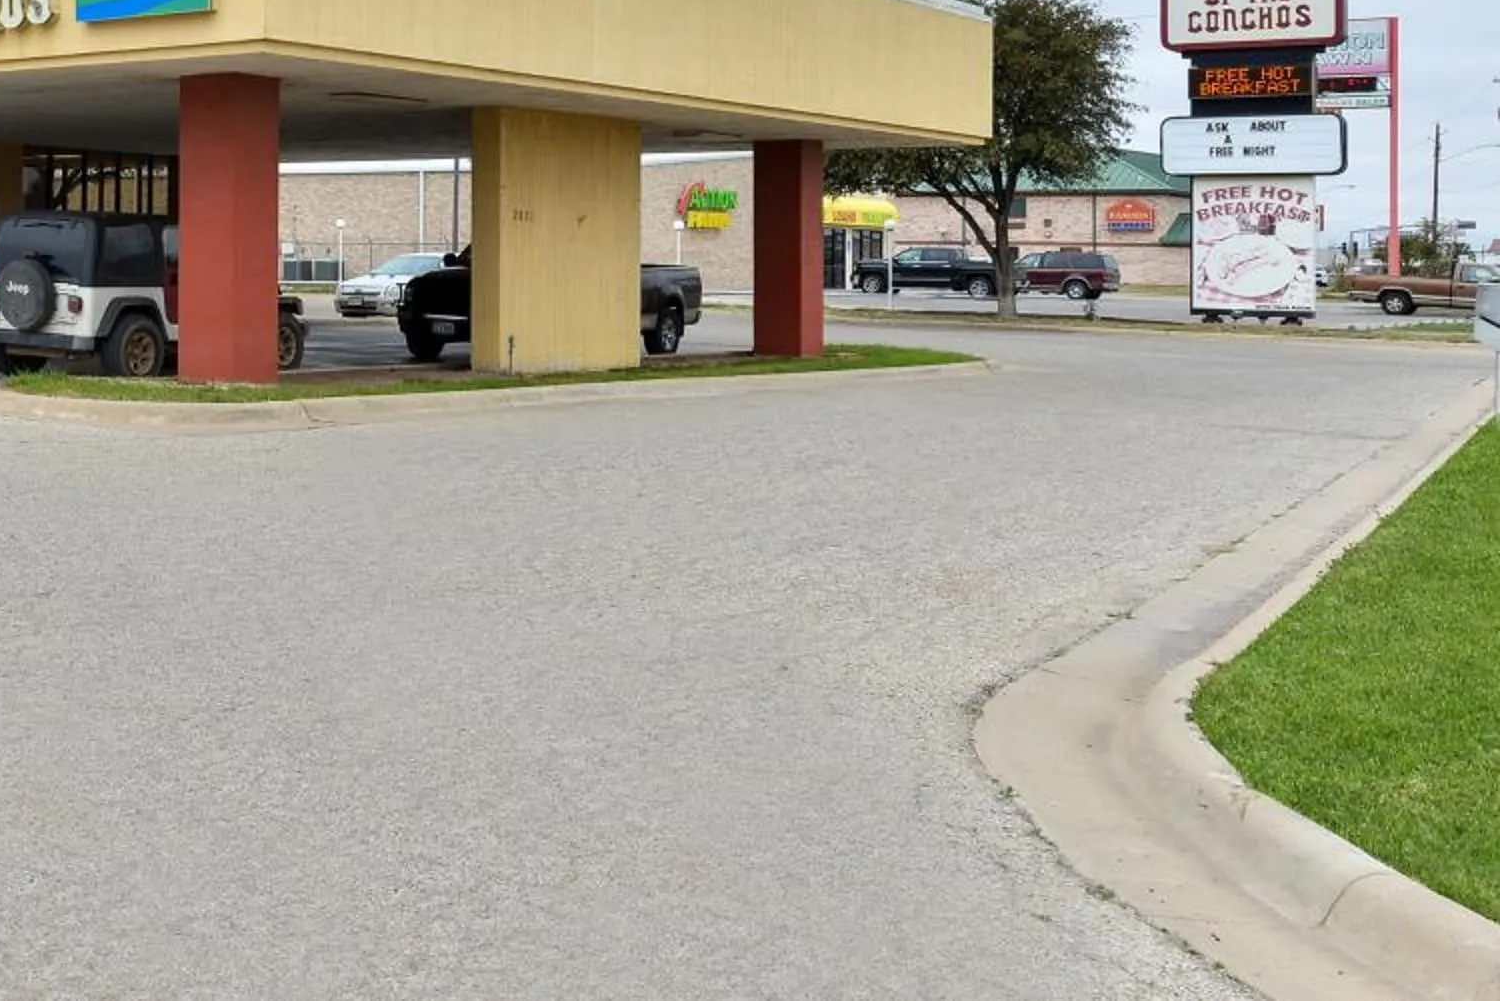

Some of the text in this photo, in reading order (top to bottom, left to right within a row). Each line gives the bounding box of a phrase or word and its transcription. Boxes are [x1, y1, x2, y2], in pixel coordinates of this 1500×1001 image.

[1187, 3, 1312, 33] CONCHOS
[1205, 66, 1295, 82] FREE HOT
[1200, 79, 1300, 96] BREAKFAST
[1206, 120, 1287, 133] ASK ABOUT
[1209, 146, 1276, 157] FREE NIGHT
[1201, 185, 1308, 205] FREE HOT
